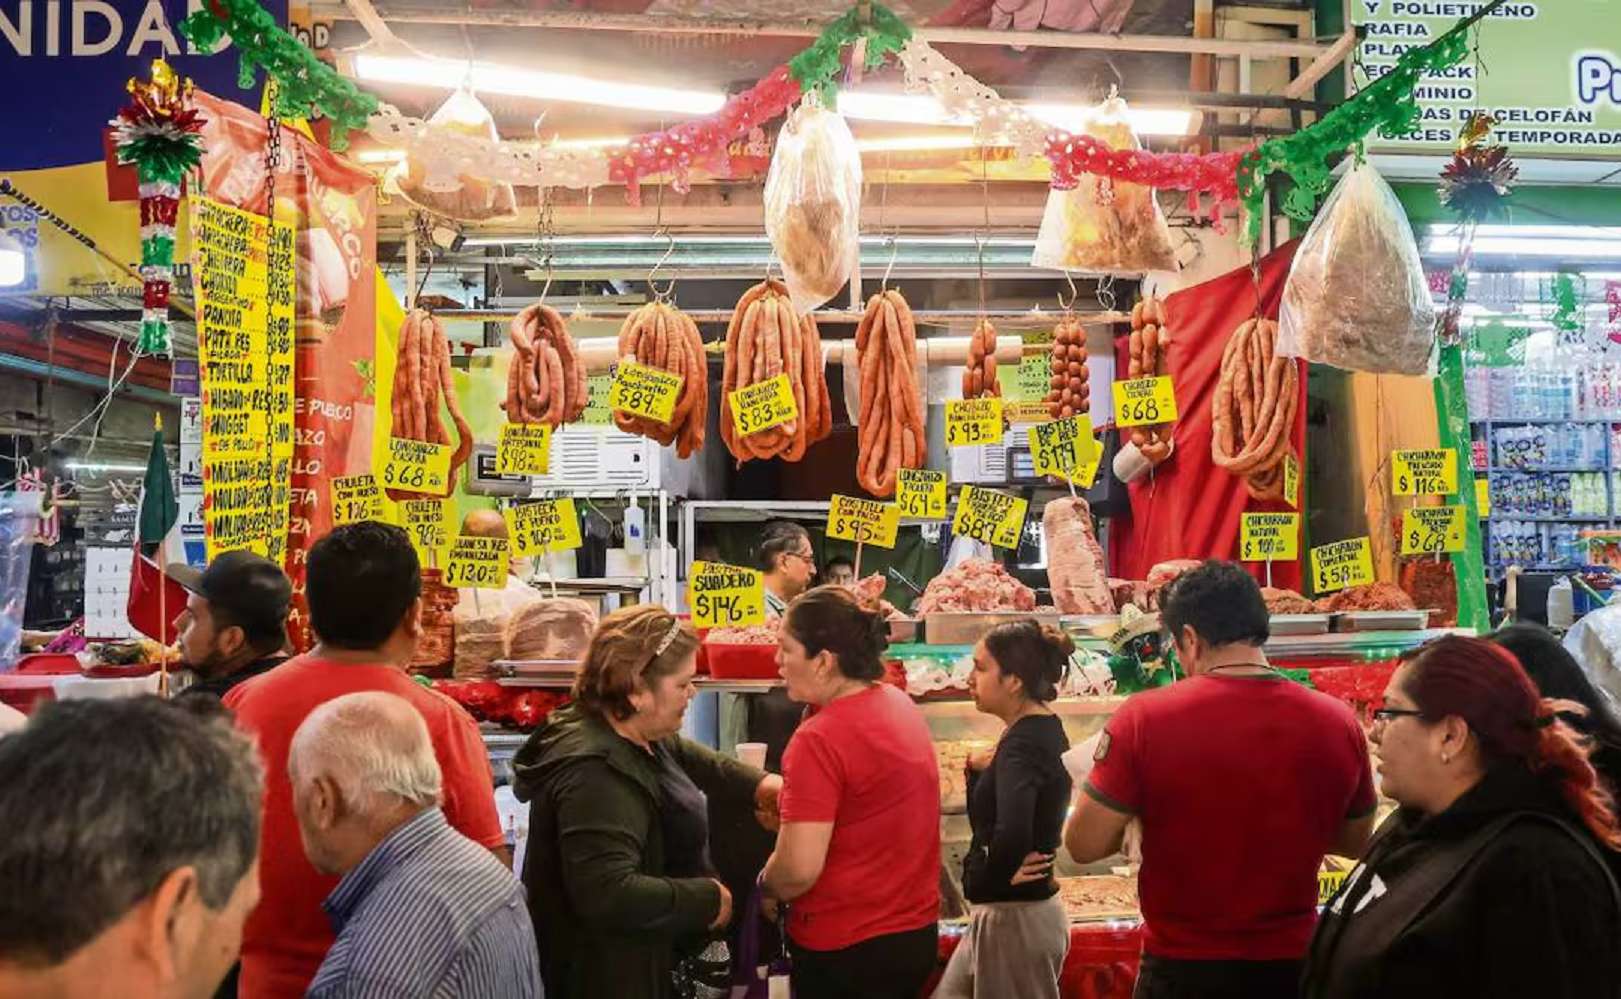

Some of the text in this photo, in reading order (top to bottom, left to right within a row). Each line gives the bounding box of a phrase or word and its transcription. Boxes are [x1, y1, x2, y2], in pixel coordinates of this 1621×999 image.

[1364, 3, 1379, 14] Y
[1365, 23, 1428, 36] RAFIA
[1413, 88, 1472, 99] MINIO
[1494, 108, 1592, 123] CELOFÁN
[1494, 130, 1621, 144] TEMPORADA
[618, 388, 655, 414] $89
[1121, 398, 1159, 421] $68
[739, 403, 773, 431] $83
[947, 422, 981, 443] $93
[333, 475, 376, 490] CHULETA
[384, 463, 425, 487] $68
[1409, 530, 1446, 552] $68
[446, 561, 488, 584] $130
[694, 572, 755, 591] SUADERO
[695, 593, 743, 624] $146
